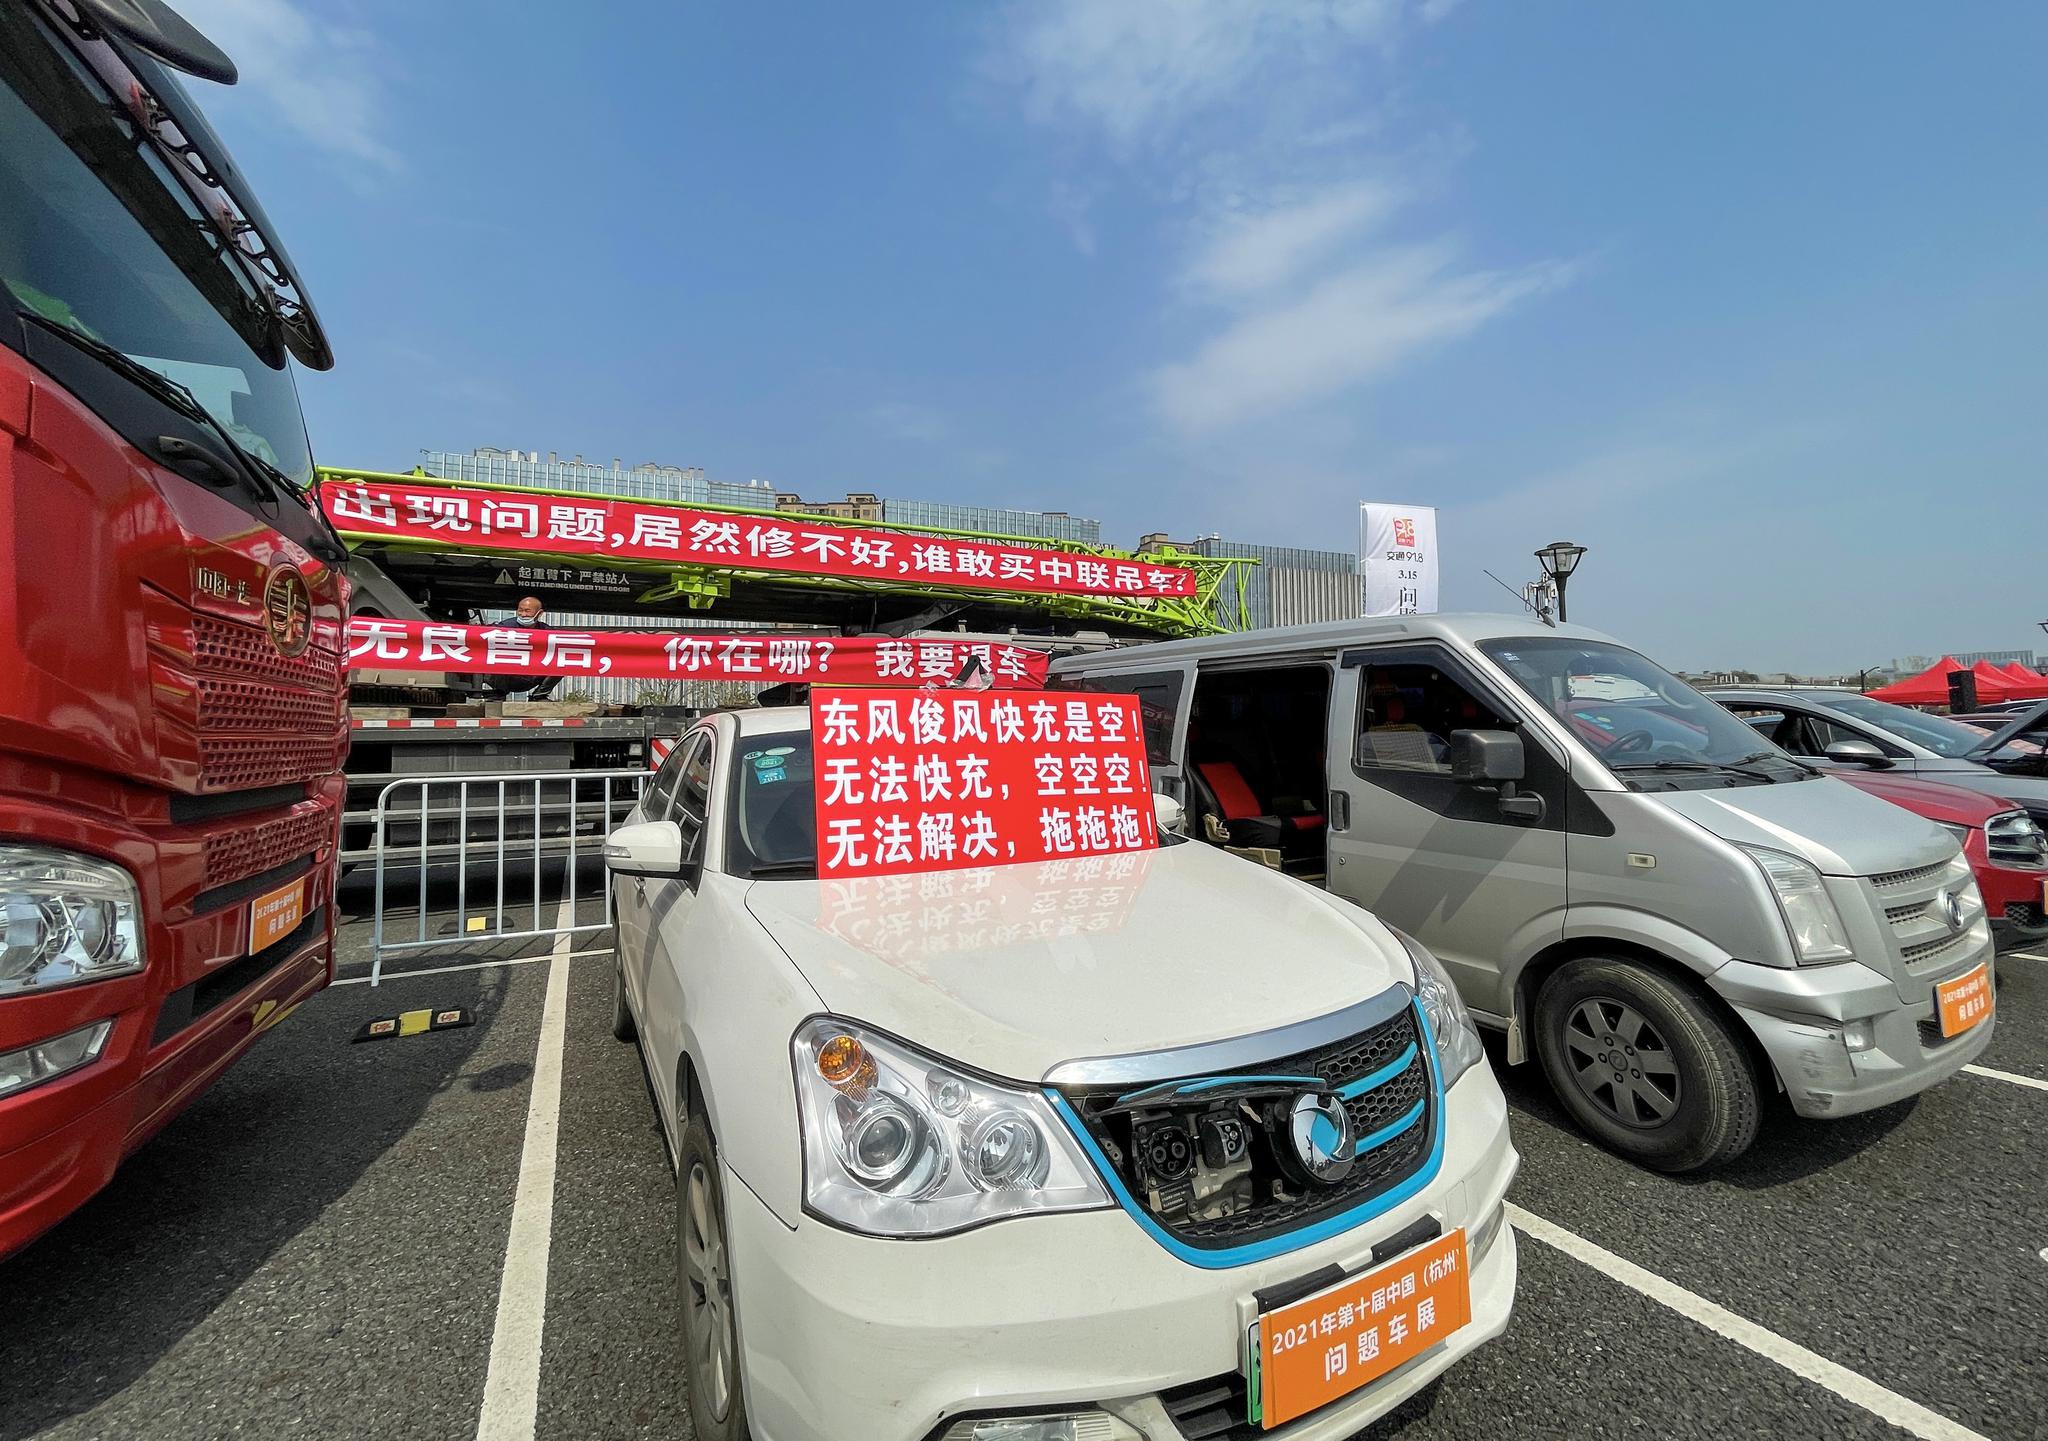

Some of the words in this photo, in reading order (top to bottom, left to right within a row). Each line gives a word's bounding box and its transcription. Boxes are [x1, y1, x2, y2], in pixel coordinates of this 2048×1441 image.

[518, 566, 572, 581] 起重臂下
[579, 570, 630, 585] 严禁站人
[1398, 570, 1418, 580] 3.15
[530, 581, 569, 589] STANDING
[569, 583, 594, 591] UNDER
[820, 697, 1141, 746] 东风俊风快充是空！
